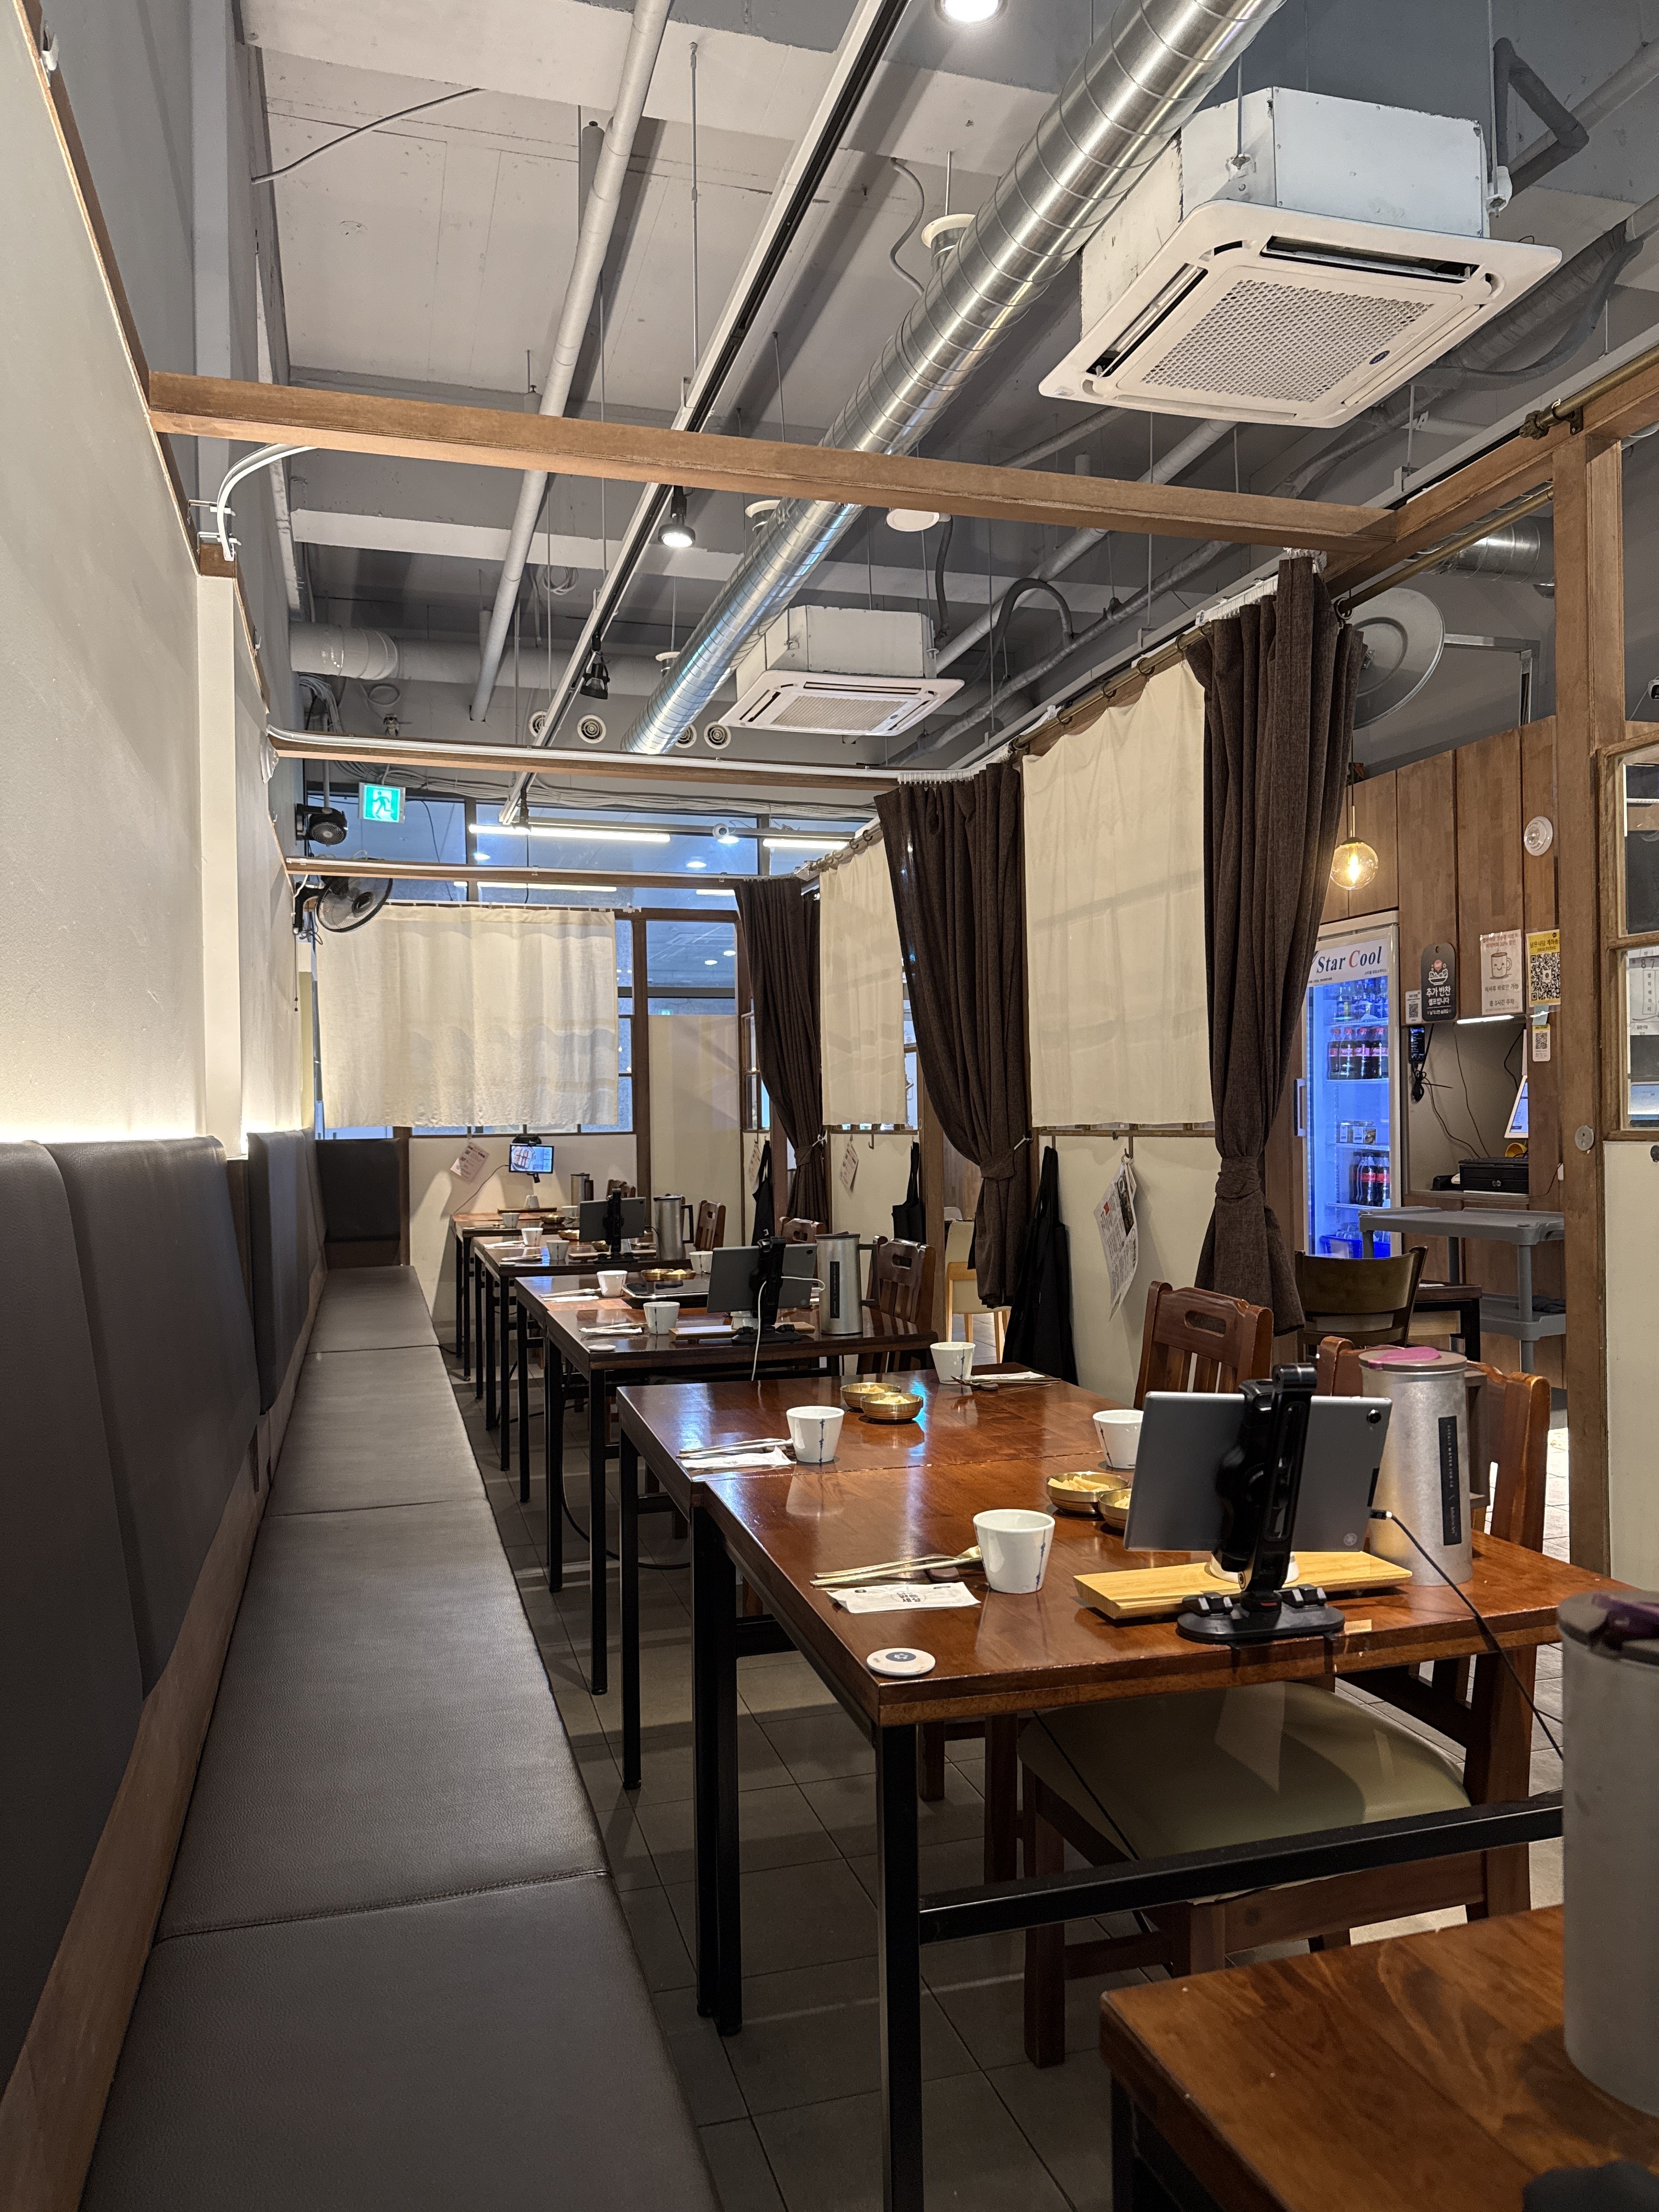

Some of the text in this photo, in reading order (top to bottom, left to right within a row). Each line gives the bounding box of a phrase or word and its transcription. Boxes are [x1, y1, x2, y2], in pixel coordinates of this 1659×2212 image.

[1317, 946, 1382, 974] Star Cool
[1426, 988, 1438, 997] 추가
[1438, 985, 1451, 996] 반찬
[1428, 997, 1449, 1006] 셀프입니다
